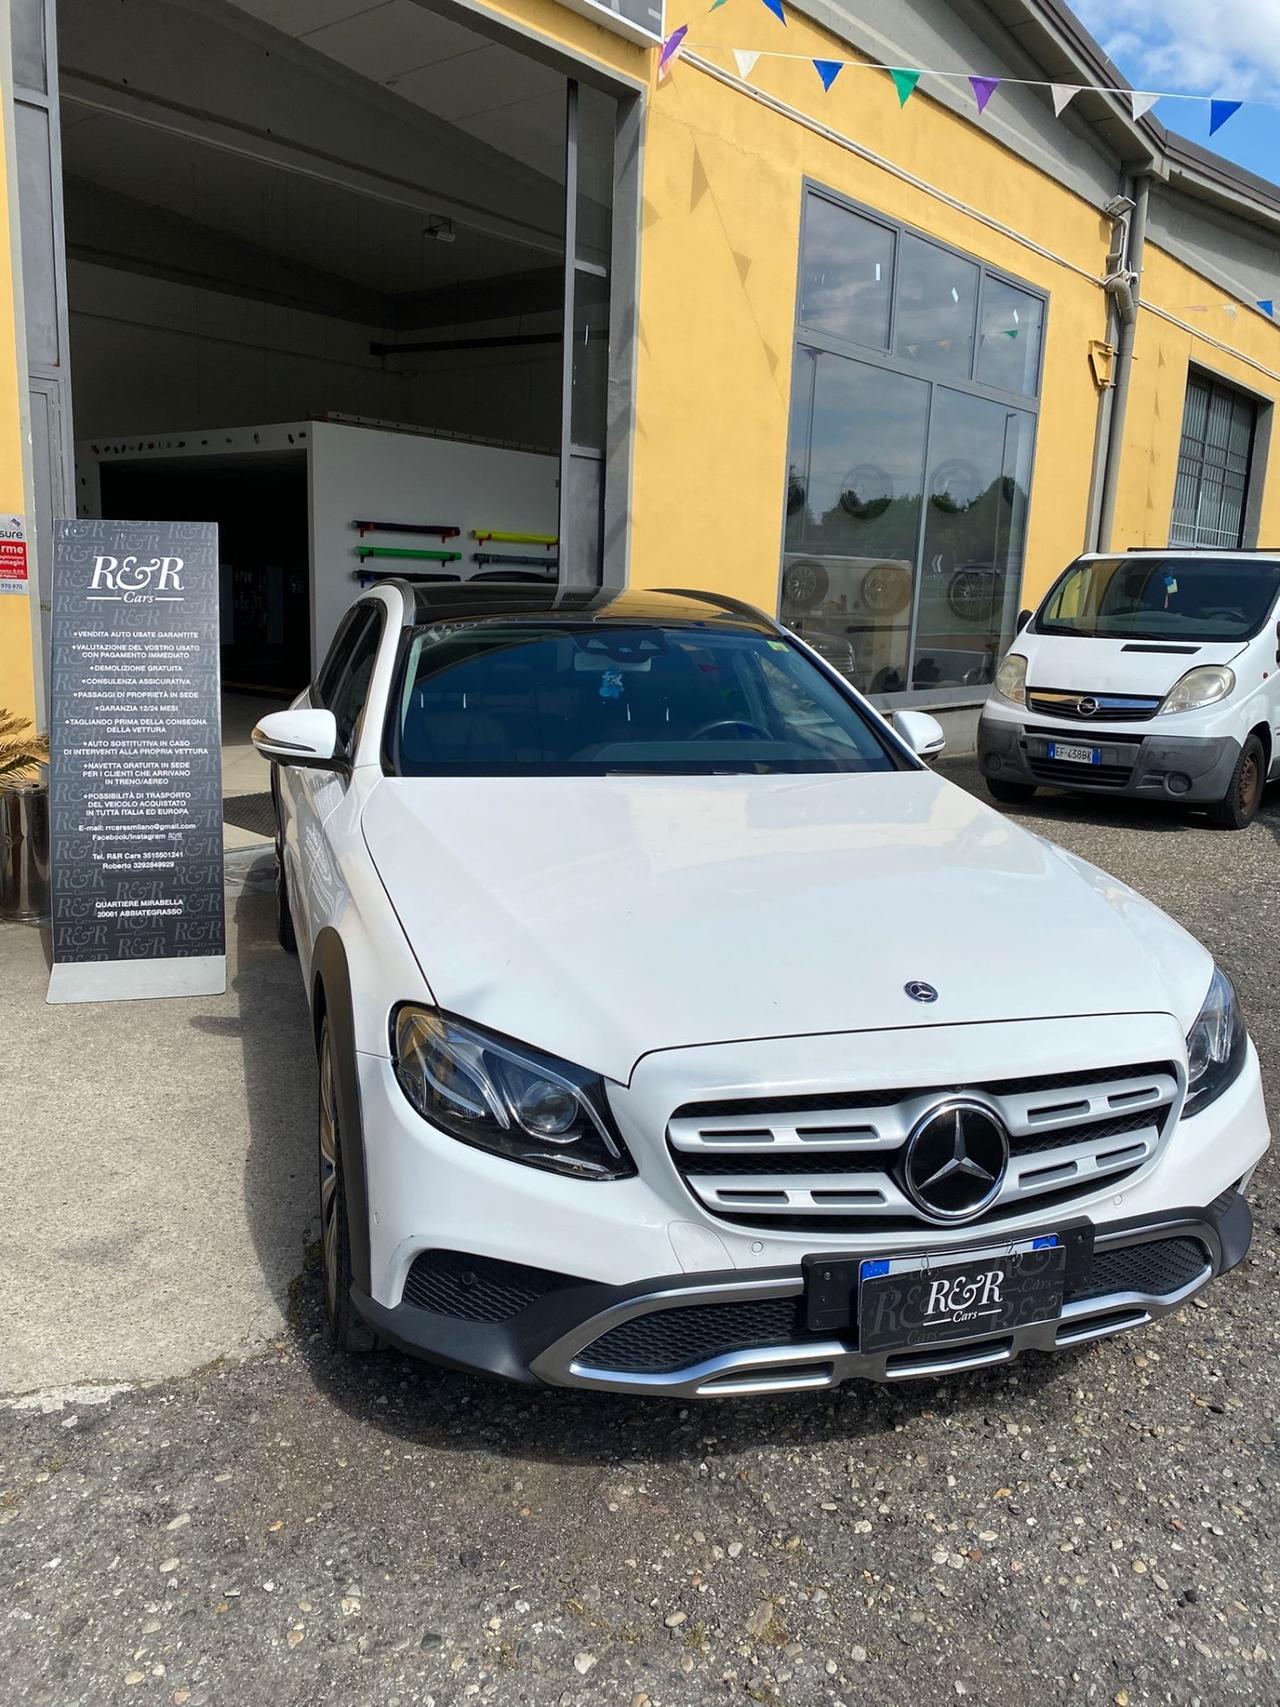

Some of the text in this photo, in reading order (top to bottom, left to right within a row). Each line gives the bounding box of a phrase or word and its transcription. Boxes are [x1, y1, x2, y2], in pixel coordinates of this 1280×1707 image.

[87, 555, 185, 590] R&R
[123, 591, 154, 603] Cars
[88, 791, 134, 800] POSSIBILITÀ
[95, 900, 139, 908] QUARTIERE
[923, 1270, 1004, 1316] R&R
[952, 1311, 979, 1323] Cars
